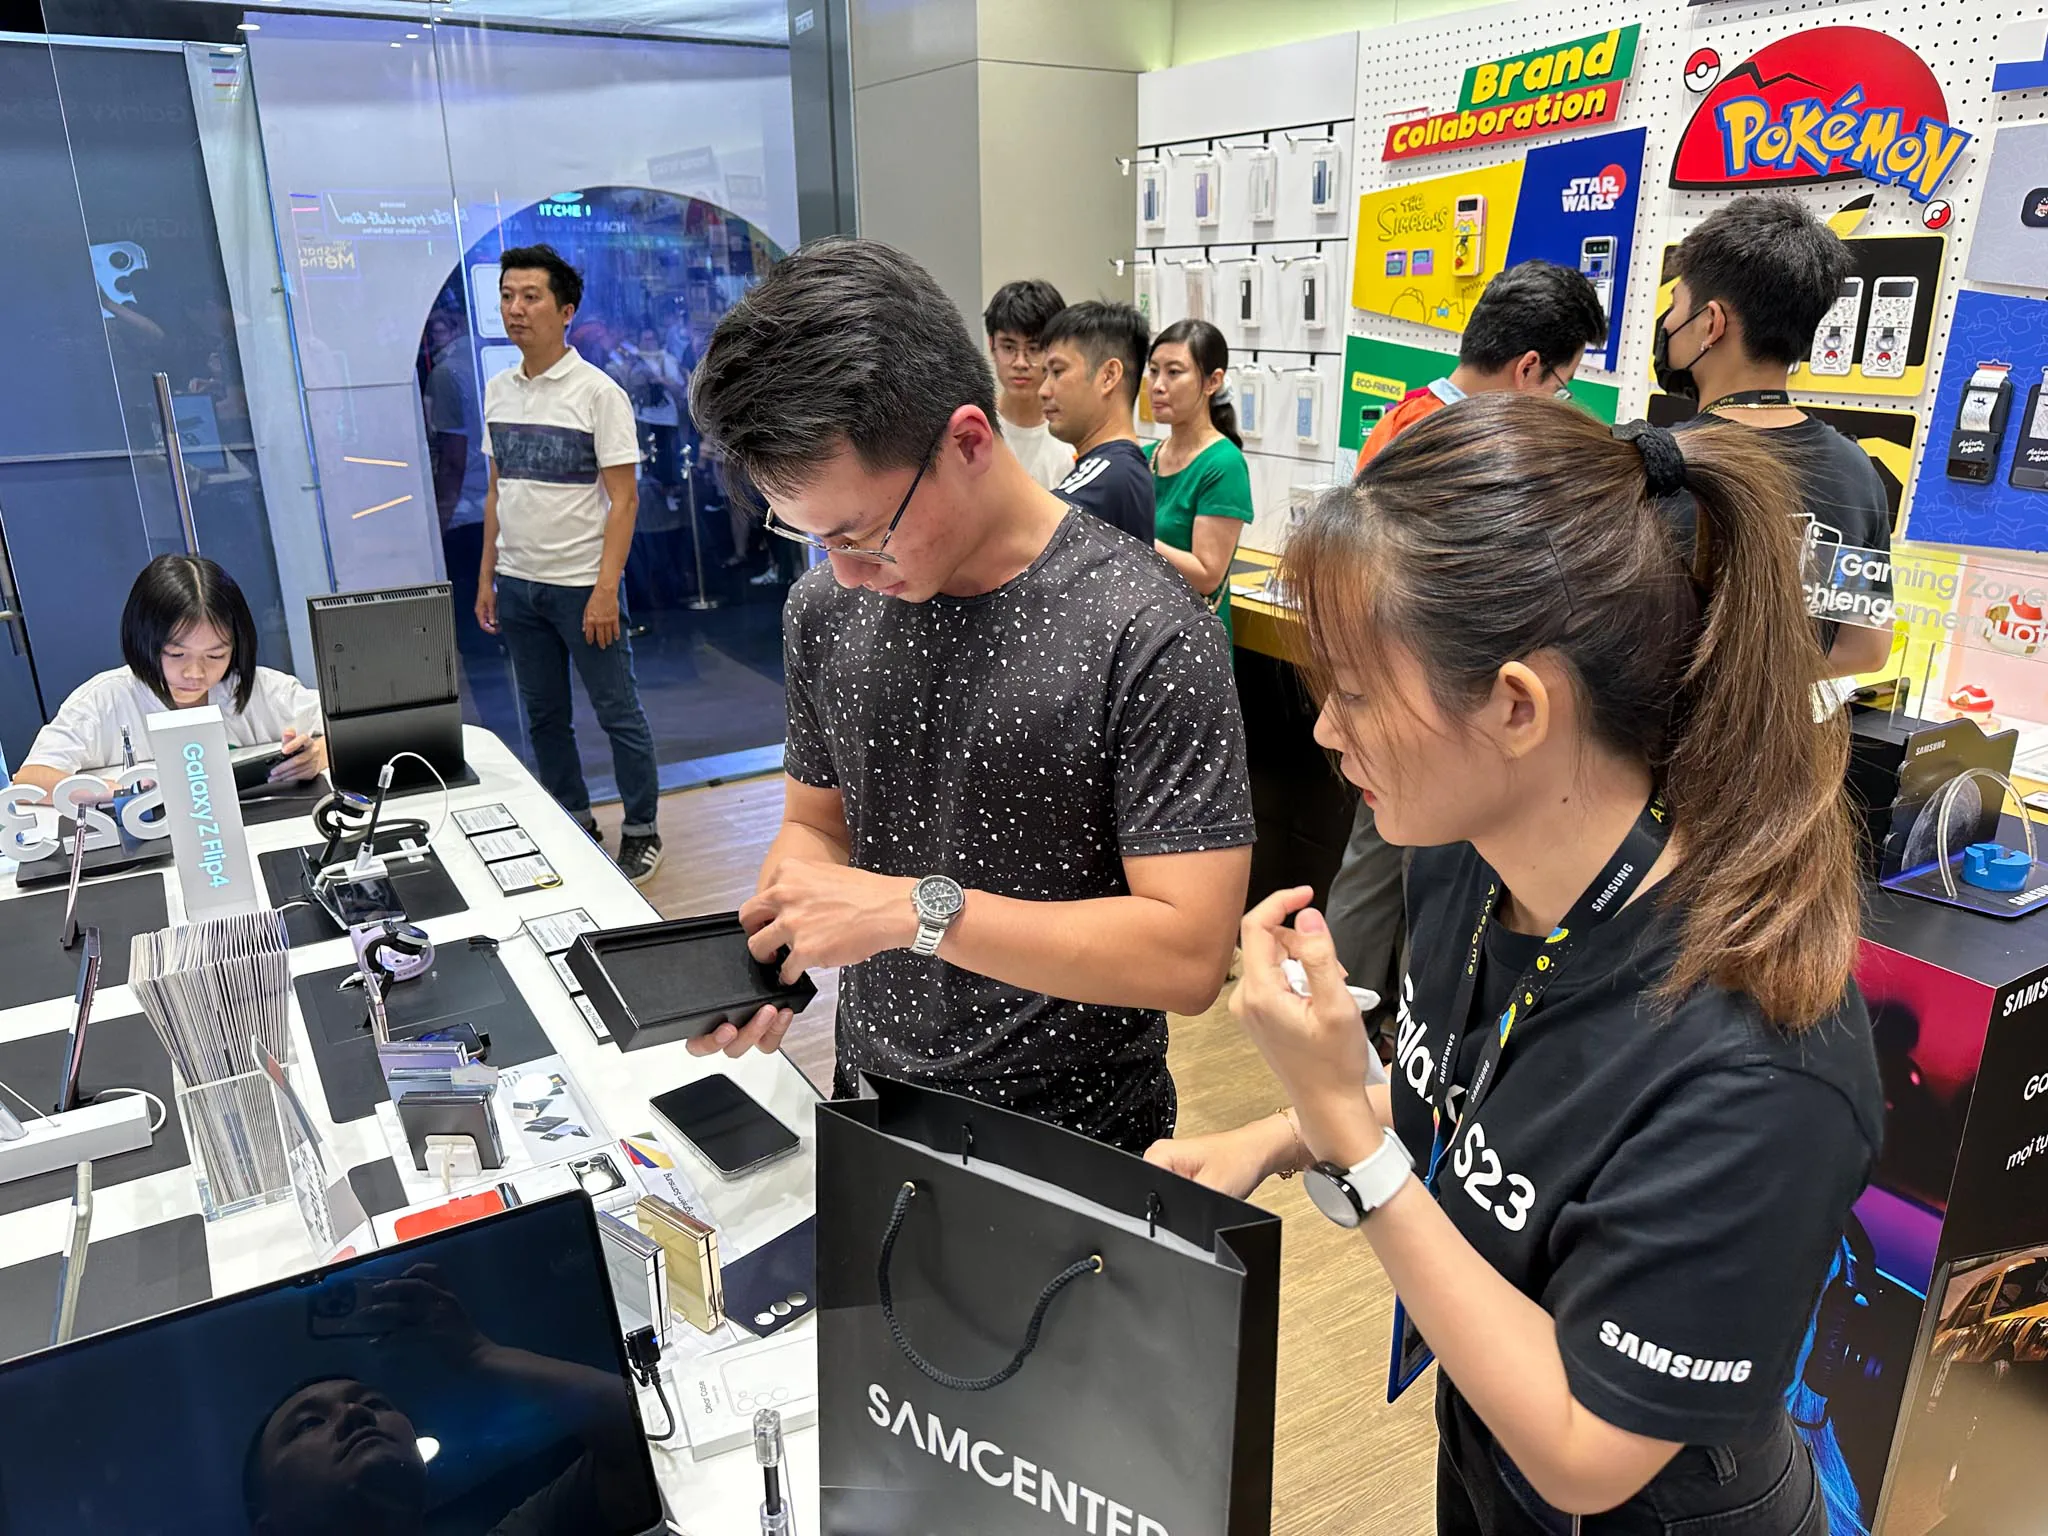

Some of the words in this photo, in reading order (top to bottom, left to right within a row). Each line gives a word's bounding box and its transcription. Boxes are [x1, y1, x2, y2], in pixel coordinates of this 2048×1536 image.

[1470, 28, 1621, 104] Brand
[1391, 87, 1608, 154] Collaboration
[1400, 194, 1424, 212] THE
[1562, 192, 1620, 213] WARS
[1563, 176, 1620, 196] STAR
[1356, 377, 1401, 396] ECO-FRIENDS
[1839, 553, 1959, 600] Gaming
[1965, 574, 2048, 607] Zone
[1915, 739, 1947, 756] SAMSUNG
[182, 743, 212, 821] Galaxy
[197, 823, 219, 837] Z
[199, 840, 231, 888] Flip4
[1591, 862, 1634, 912] SAMSUNG
[1440, 1032, 1456, 1084] SAMSUNG
[1470, 1059, 1491, 1103] SAMSUNG
[1453, 1122, 1536, 1232] S23
[2006, 1137, 2034, 1171] mọi
[663, 1172, 682, 1197] Samsung
[1599, 1320, 1753, 1383] SAMSUNG
